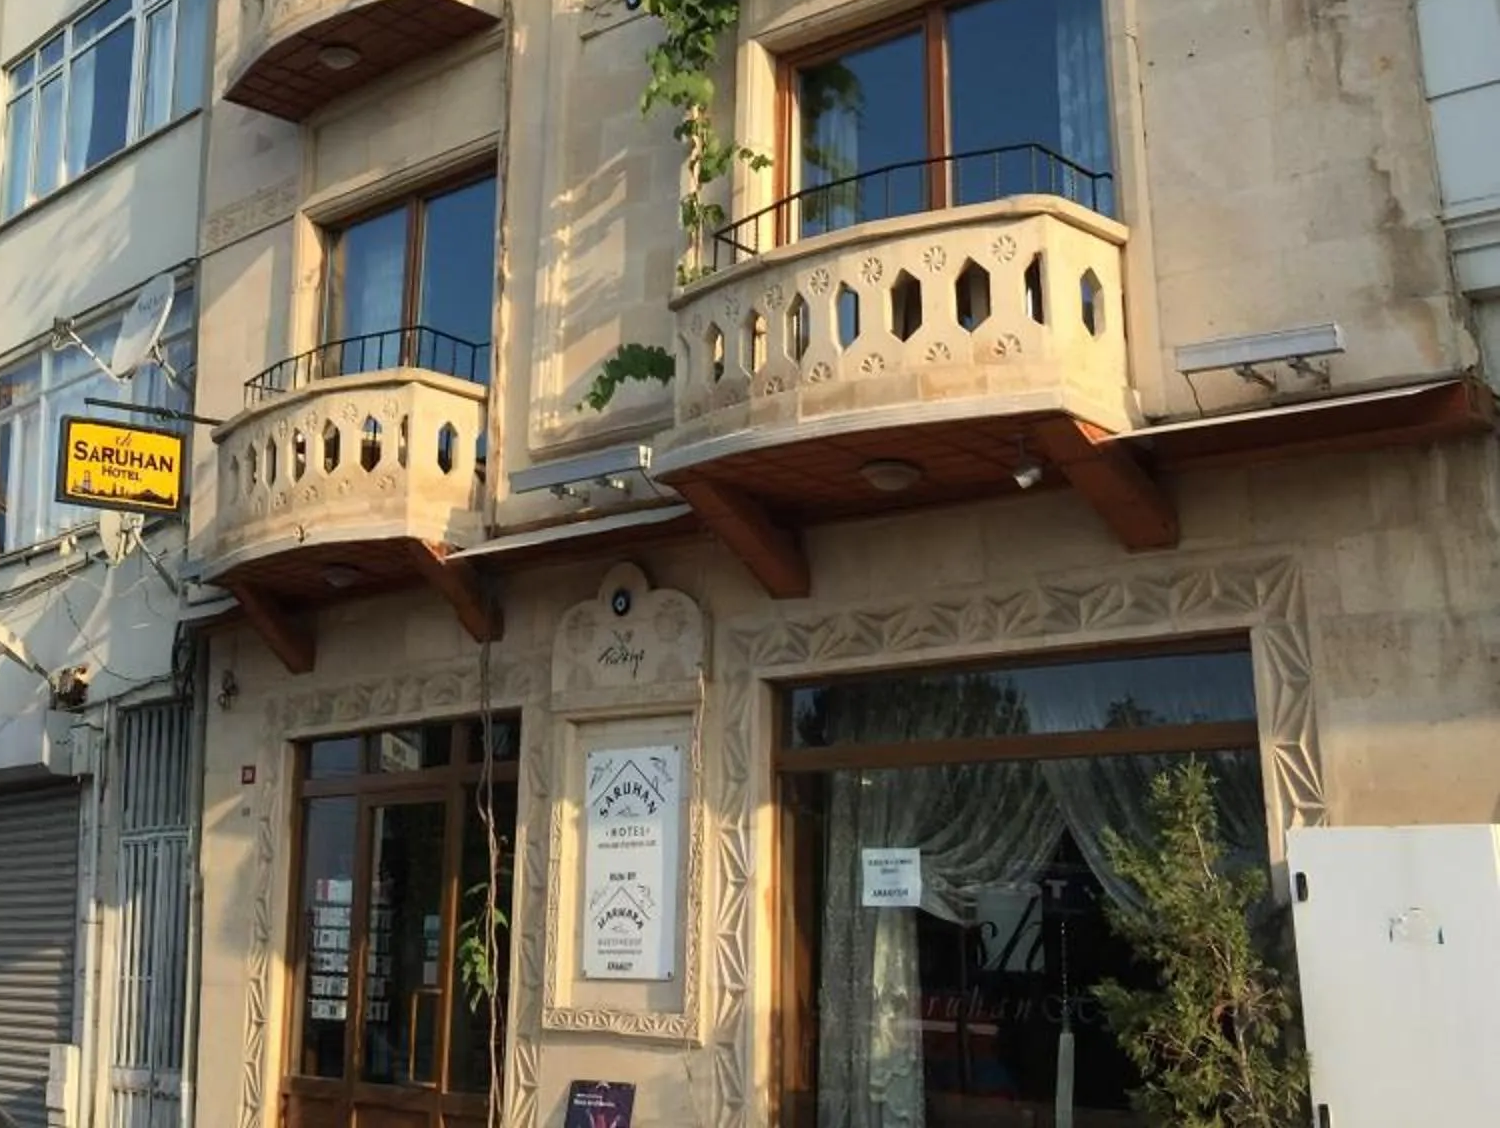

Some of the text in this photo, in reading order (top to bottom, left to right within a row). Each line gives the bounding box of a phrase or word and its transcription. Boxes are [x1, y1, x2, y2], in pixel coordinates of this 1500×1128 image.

[73, 440, 174, 473] SARUHAN
[101, 465, 140, 482] HOTEL
[599, 781, 658, 819] SARUHAN
